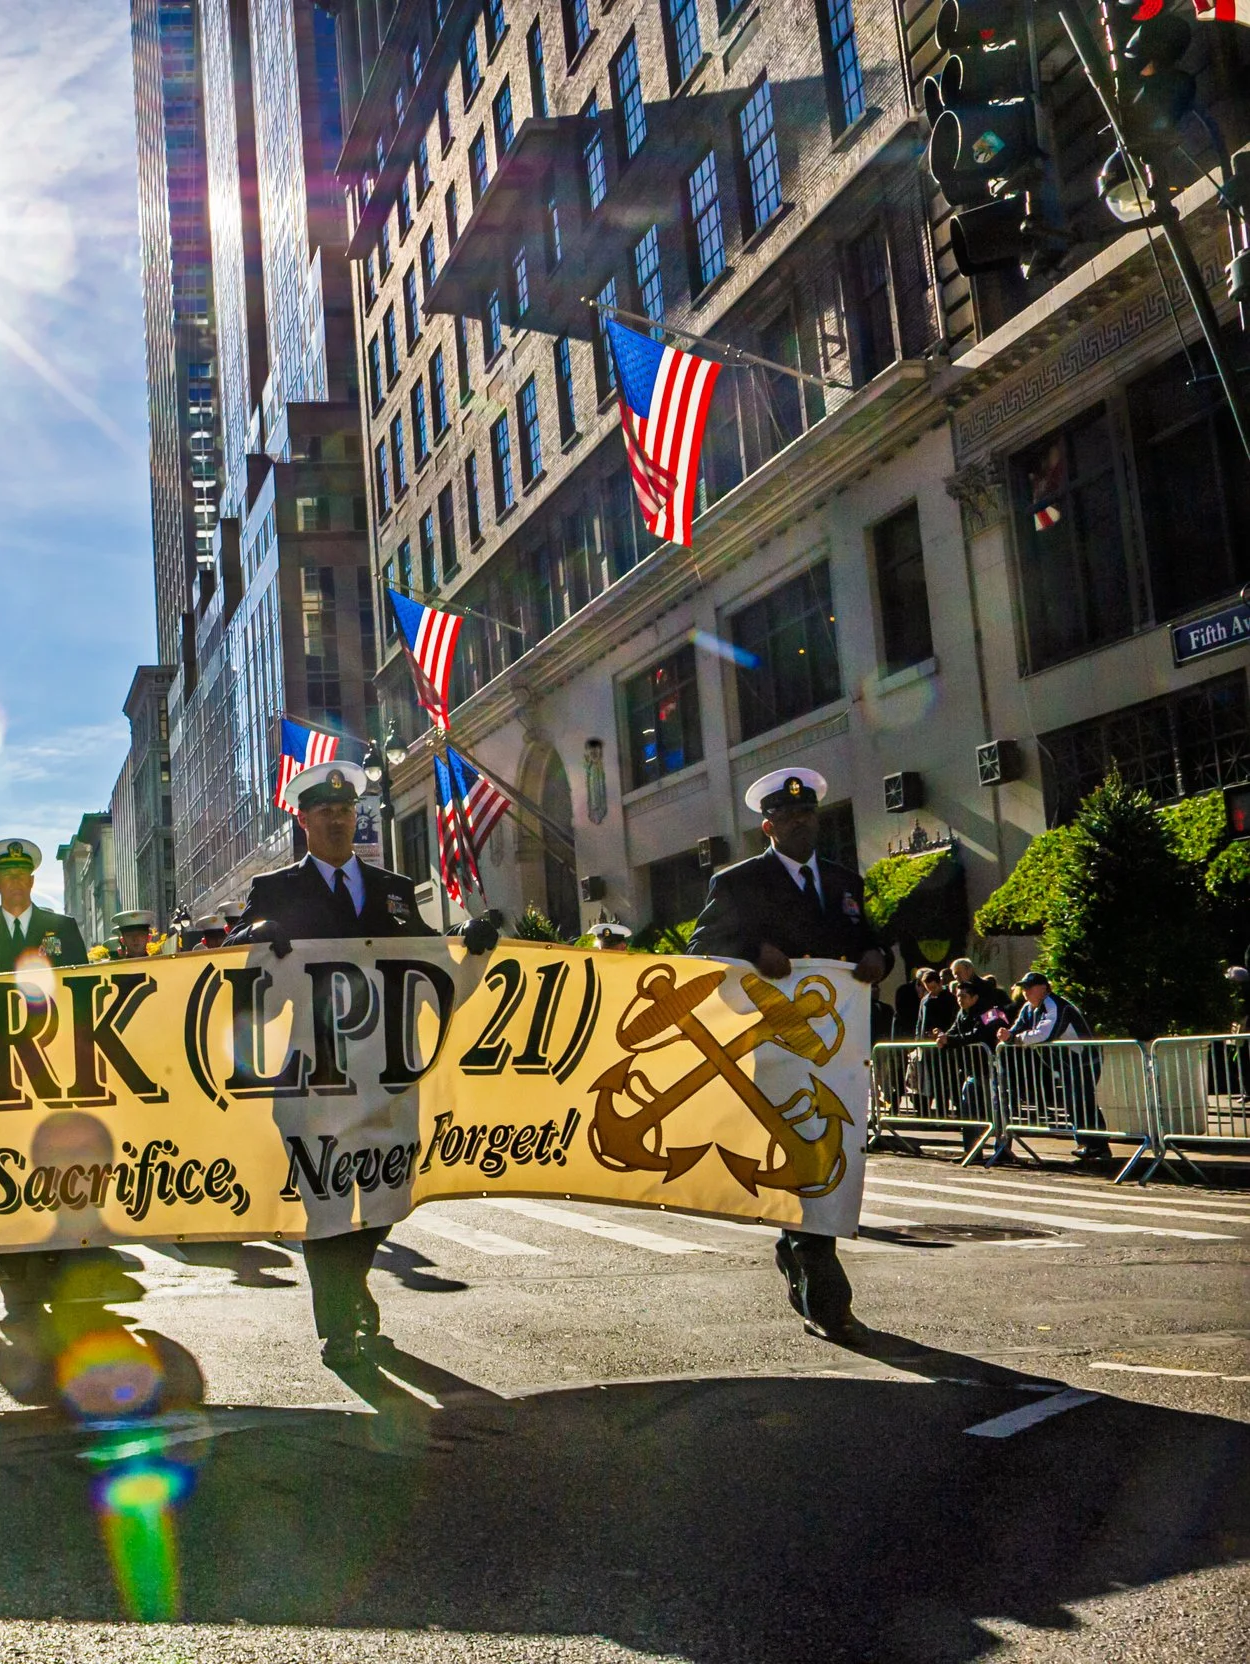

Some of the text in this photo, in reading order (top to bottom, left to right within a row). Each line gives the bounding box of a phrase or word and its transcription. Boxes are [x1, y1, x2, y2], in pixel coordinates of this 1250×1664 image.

[1189, 622, 1228, 650] Fifth
[184, 958, 455, 1111] (LPD
[459, 957, 601, 1085] 21)
[280, 1134, 422, 1202] Never
[419, 1107, 581, 1178] Forget!
